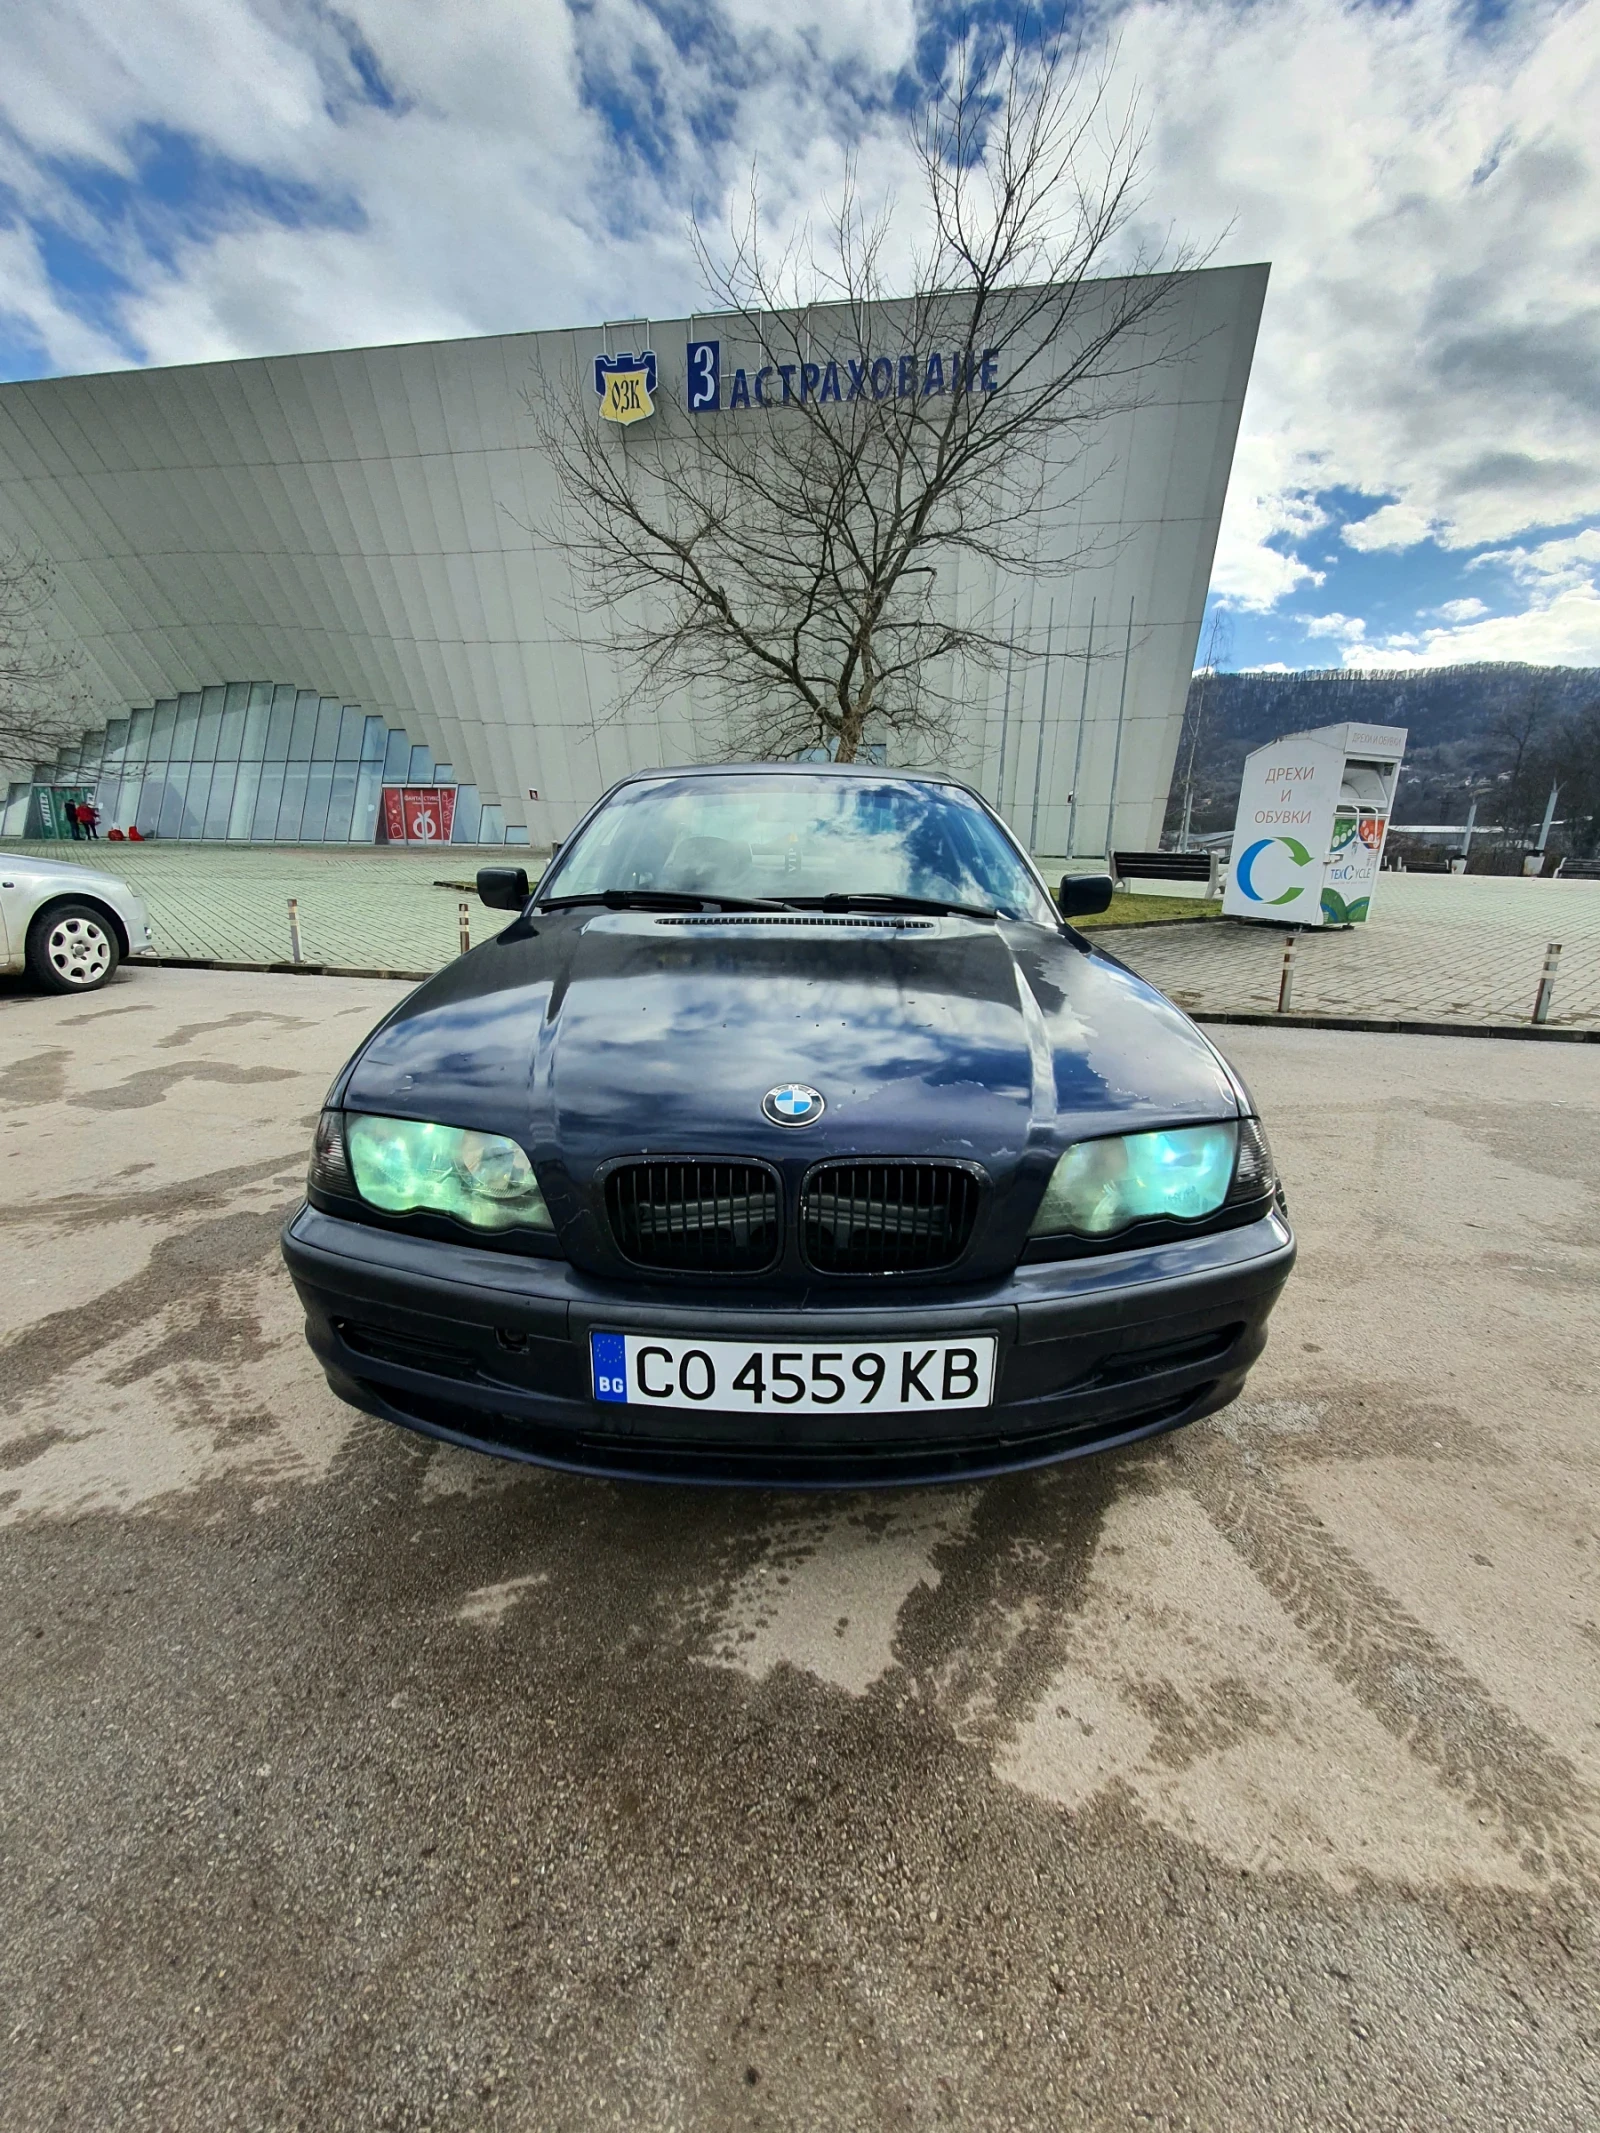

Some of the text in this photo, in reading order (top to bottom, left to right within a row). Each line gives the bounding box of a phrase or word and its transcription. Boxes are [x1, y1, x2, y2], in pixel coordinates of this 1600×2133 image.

[1265, 766, 1314, 784] ДРЕХИ
[1281, 789, 1292, 802] И
[1254, 810, 1312, 824] ОБУВКИ
[599, 1376, 624, 1393] BG
[732, 1352, 886, 1404] 4559
[900, 1348, 979, 1402] KB
